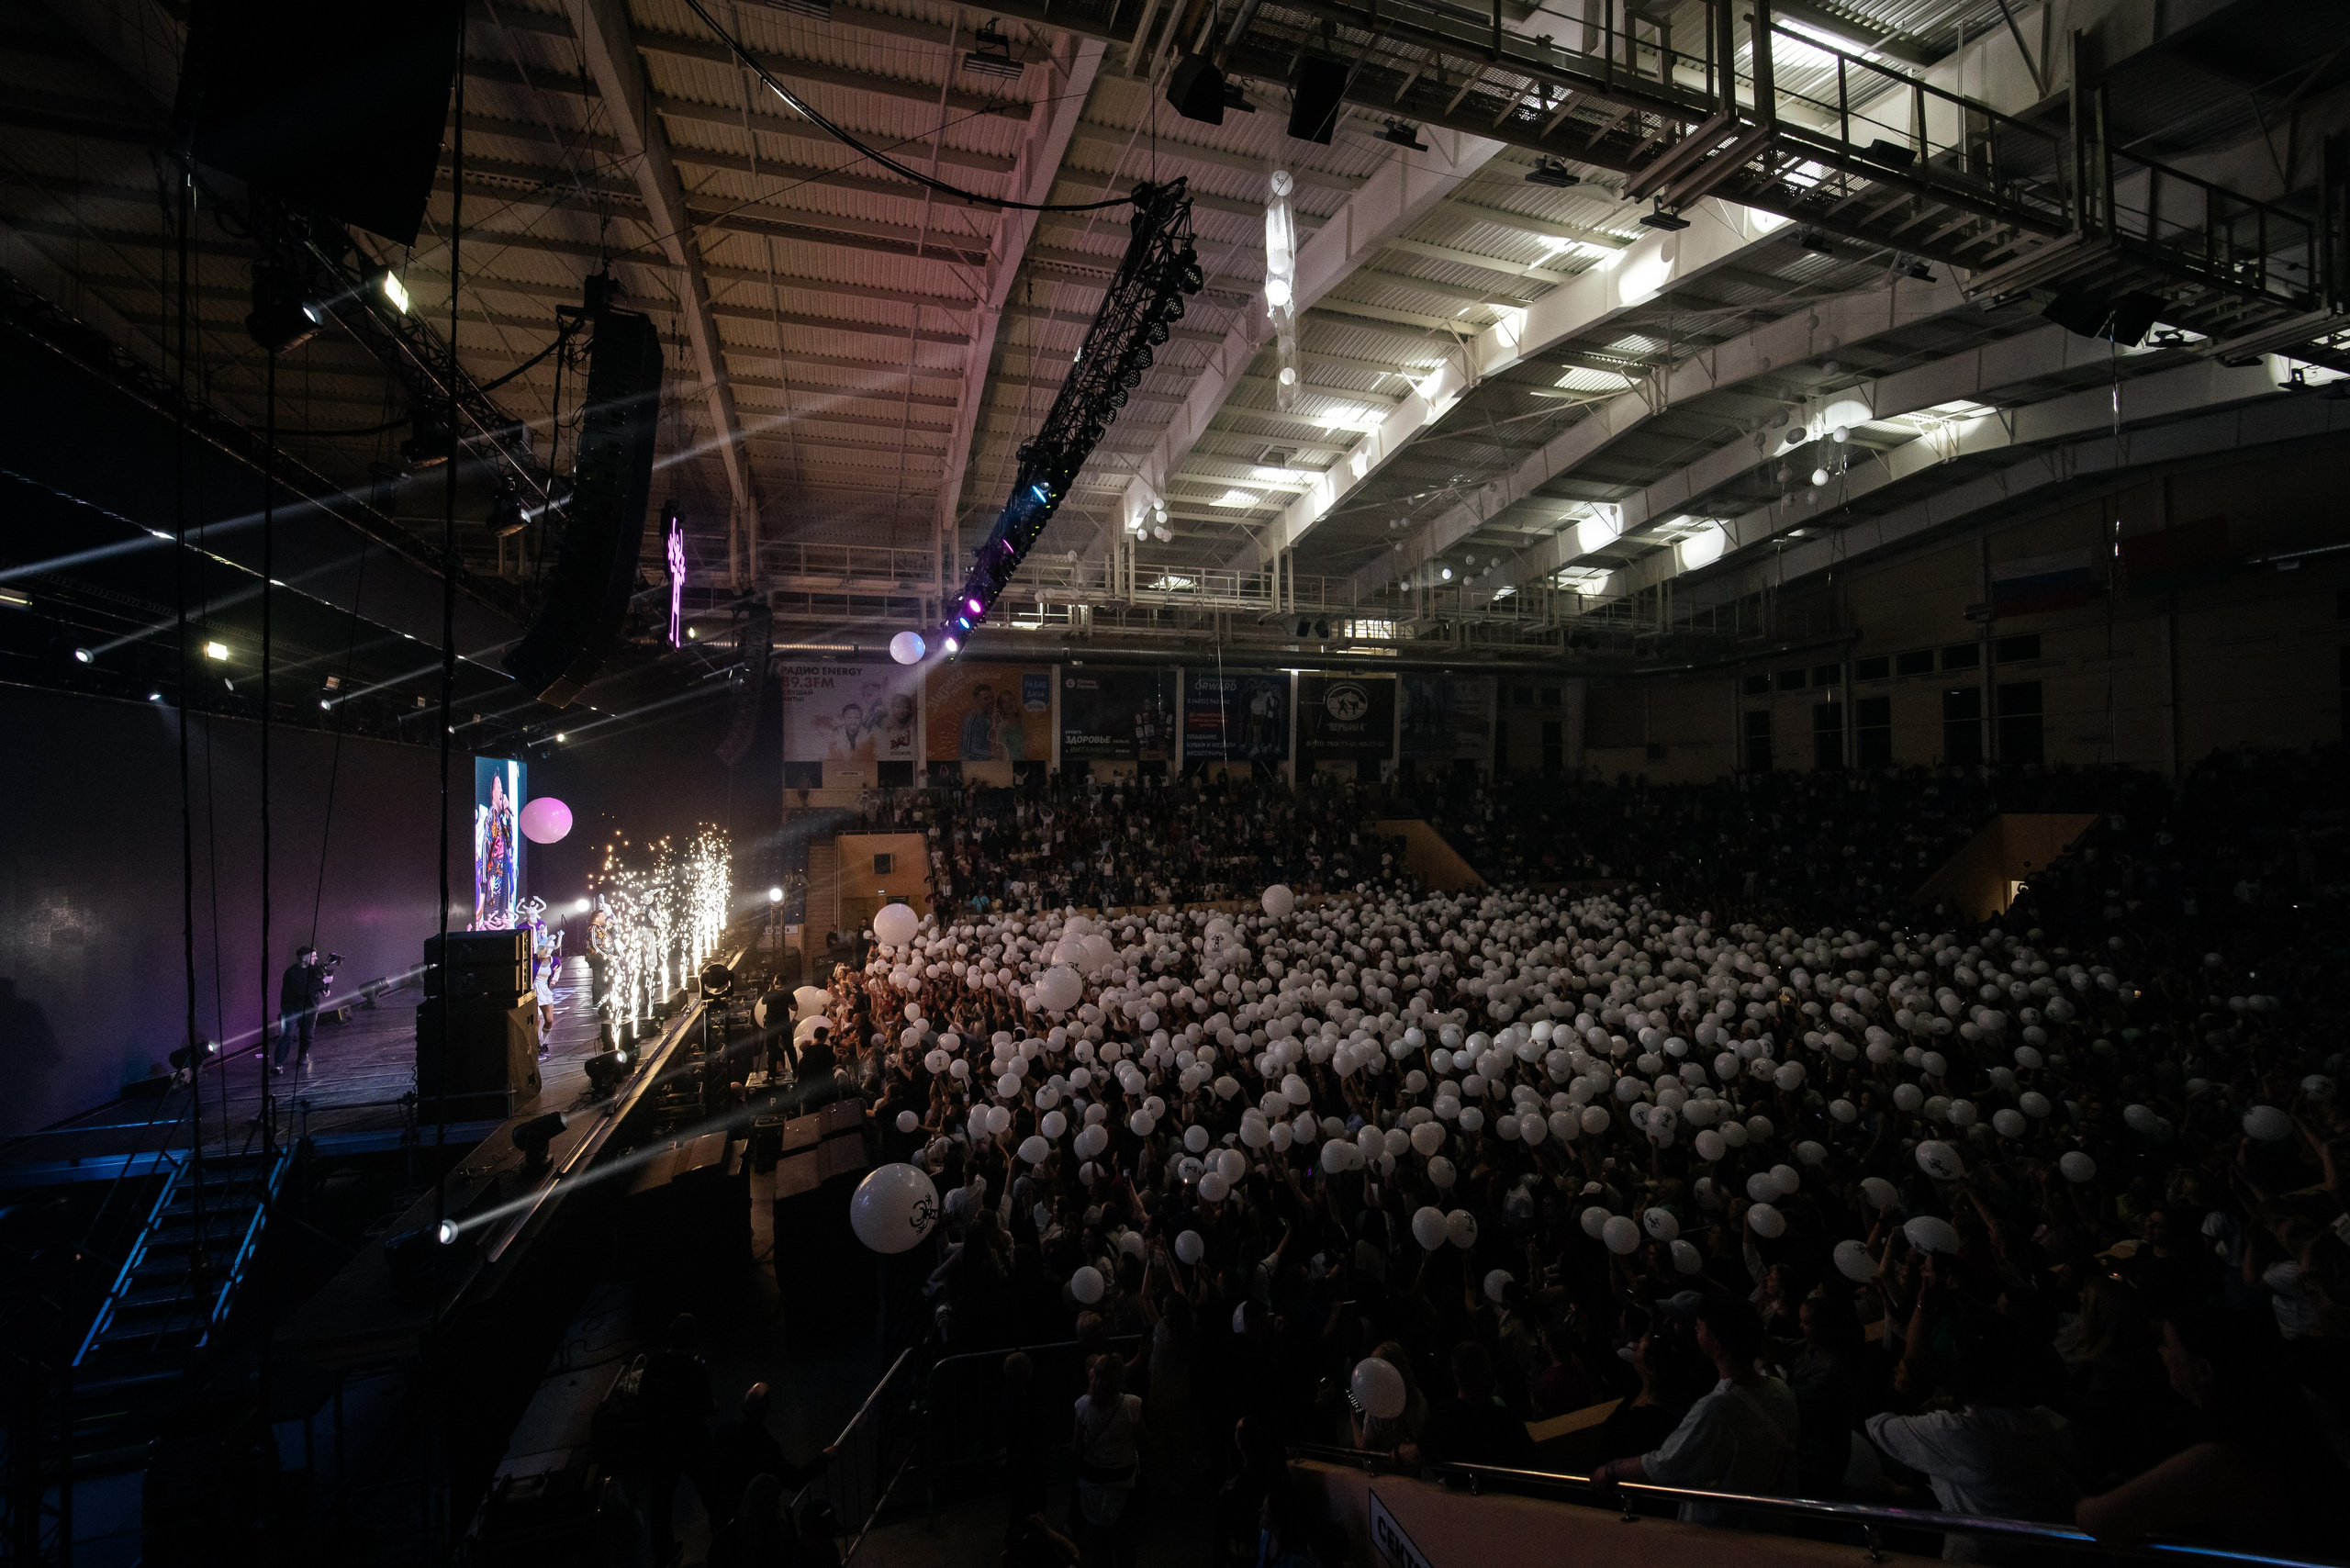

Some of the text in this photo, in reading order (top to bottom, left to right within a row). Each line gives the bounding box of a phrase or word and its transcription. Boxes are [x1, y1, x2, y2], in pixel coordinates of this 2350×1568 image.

[781, 666, 863, 676] РАДИО ENERGY
[782, 677, 834, 689] 89.3FM
[1065, 735, 1111, 745] ЗДОРОВЬЕ
[1378, 1516, 1421, 1568] СЕКТ
